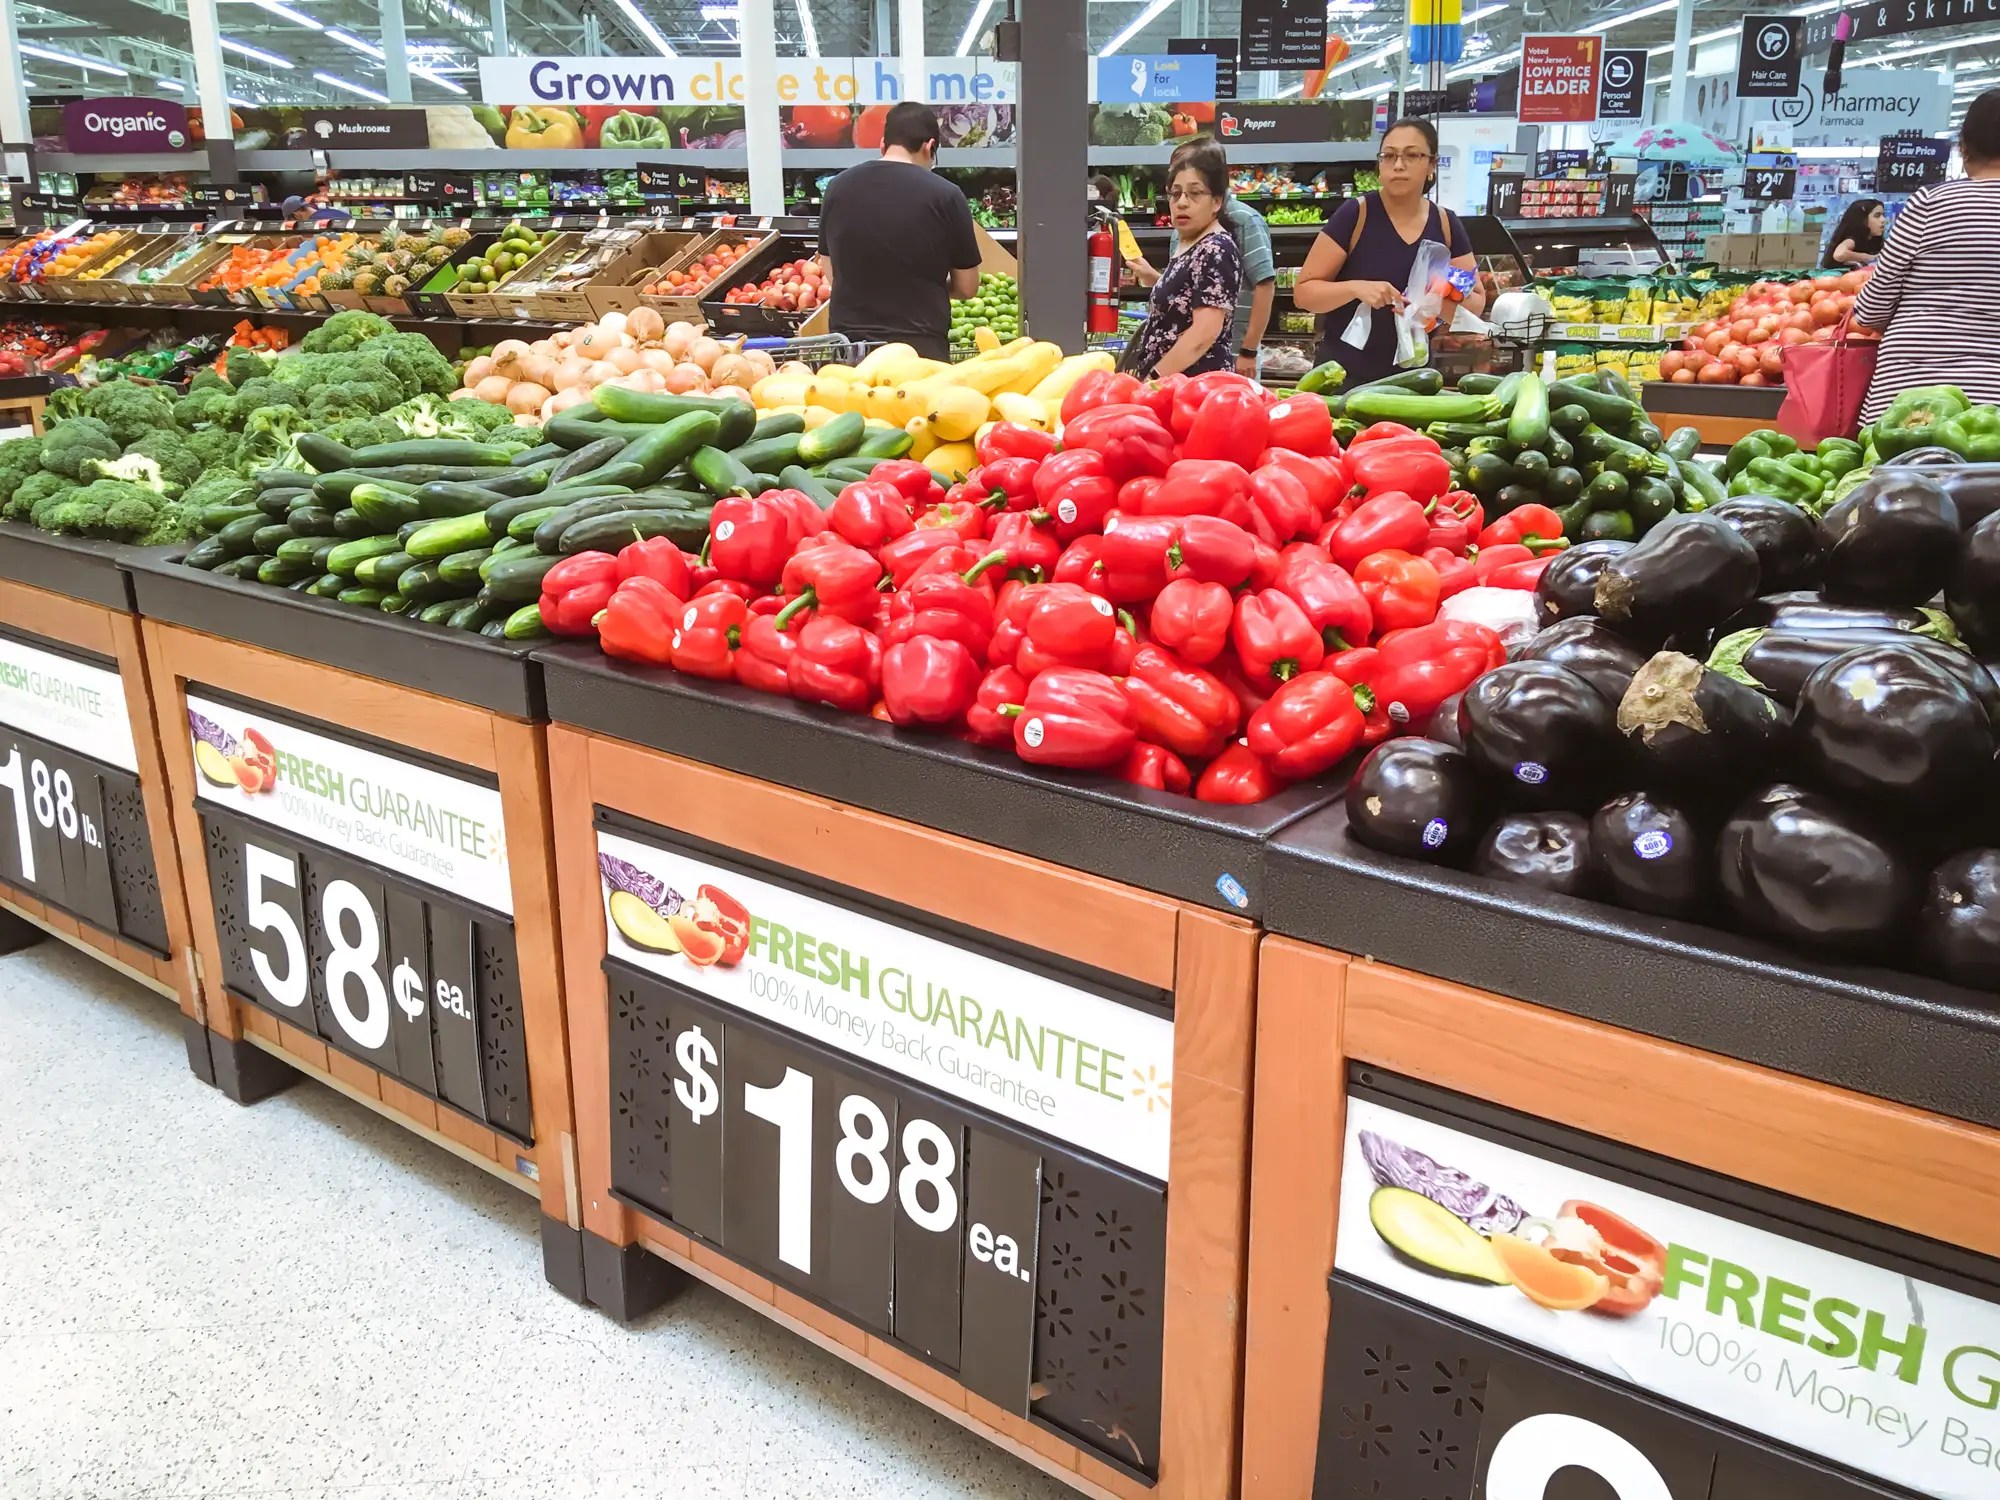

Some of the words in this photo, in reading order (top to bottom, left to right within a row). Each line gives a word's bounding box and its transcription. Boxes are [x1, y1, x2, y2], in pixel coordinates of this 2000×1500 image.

[1807, 17, 1859, 45] Beauy
[1877, 8, 1887, 27] &
[1201, 44, 1206, 52] 4
[1577, 40, 1593, 63] #1
[1154, 61, 1181, 72] Look
[1528, 56, 1544, 64] New
[1545, 56, 1572, 65] Jersey's
[529, 60, 674, 100] Grown
[690, 61, 800, 100] cloe
[813, 65, 859, 100] to
[874, 61, 1006, 100] hme.
[1154, 73, 1171, 84] for
[1526, 66, 1553, 78] LOW
[1556, 66, 1591, 77] PRICE
[1752, 70, 1766, 80] Hair
[1769, 70, 1787, 80] Care
[1154, 86, 1182, 97] local.
[1525, 80, 1590, 95] LEADER
[1602, 92, 1631, 100] Personal
[1608, 100, 1624, 108] Care
[1821, 92, 1921, 117] Pharmacy
[84, 111, 167, 138] Organic
[338, 122, 391, 134] Mushrooms
[1243, 118, 1276, 130] Peppers
[1820, 116, 1864, 127] Farmacia
[1897, 146, 1914, 155] Low
[1915, 146, 1936, 156] Price
[1890, 162, 1924, 177] $164
[30, 671, 104, 718] GUARANTEE
[276, 749, 346, 806] FRESH
[350, 777, 487, 860] GUARANTEE
[82, 812, 102, 849] lb.
[279, 791, 312, 820] 100%
[312, 801, 352, 843] Money
[356, 820, 388, 851] Back
[389, 833, 454, 879] Guarantee
[436, 976, 472, 1021] ea.
[748, 914, 870, 999] FRESH
[878, 967, 1126, 1102] GUARANTEE
[747, 968, 799, 1011] 100%
[804, 989, 877, 1047] Money
[882, 1020, 932, 1066] Back
[938, 1045, 1057, 1117] Guarantee
[969, 1220, 1030, 1283] ea.
[1662, 1242, 1928, 1386] FRESH
[1657, 1316, 1762, 1383] 100%
[1776, 1358, 1928, 1448] Money
